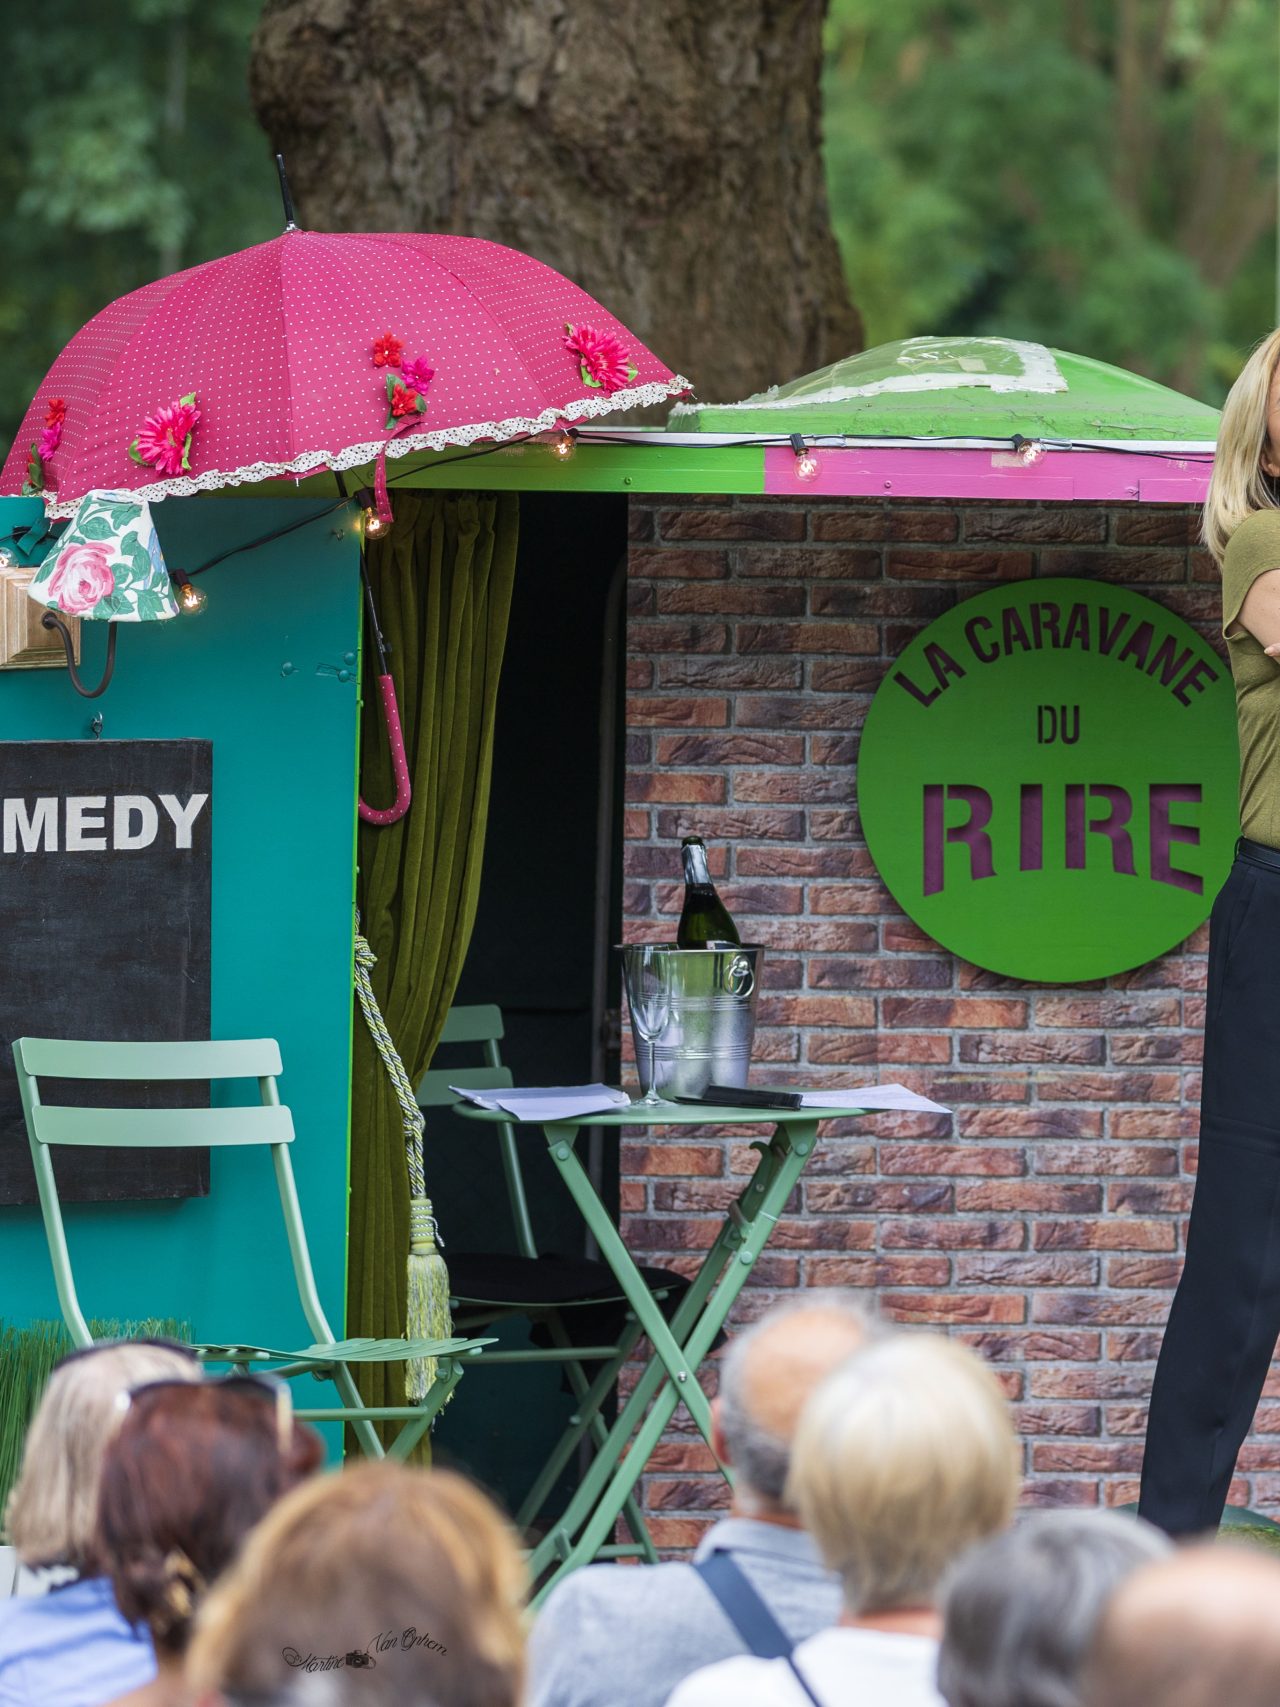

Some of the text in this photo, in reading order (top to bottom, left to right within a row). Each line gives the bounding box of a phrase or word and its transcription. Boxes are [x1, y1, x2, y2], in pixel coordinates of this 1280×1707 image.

[892, 602, 1220, 708] LA CARAVANE
[1037, 704, 1080, 745] DU
[922, 783, 1205, 897] RIRE
